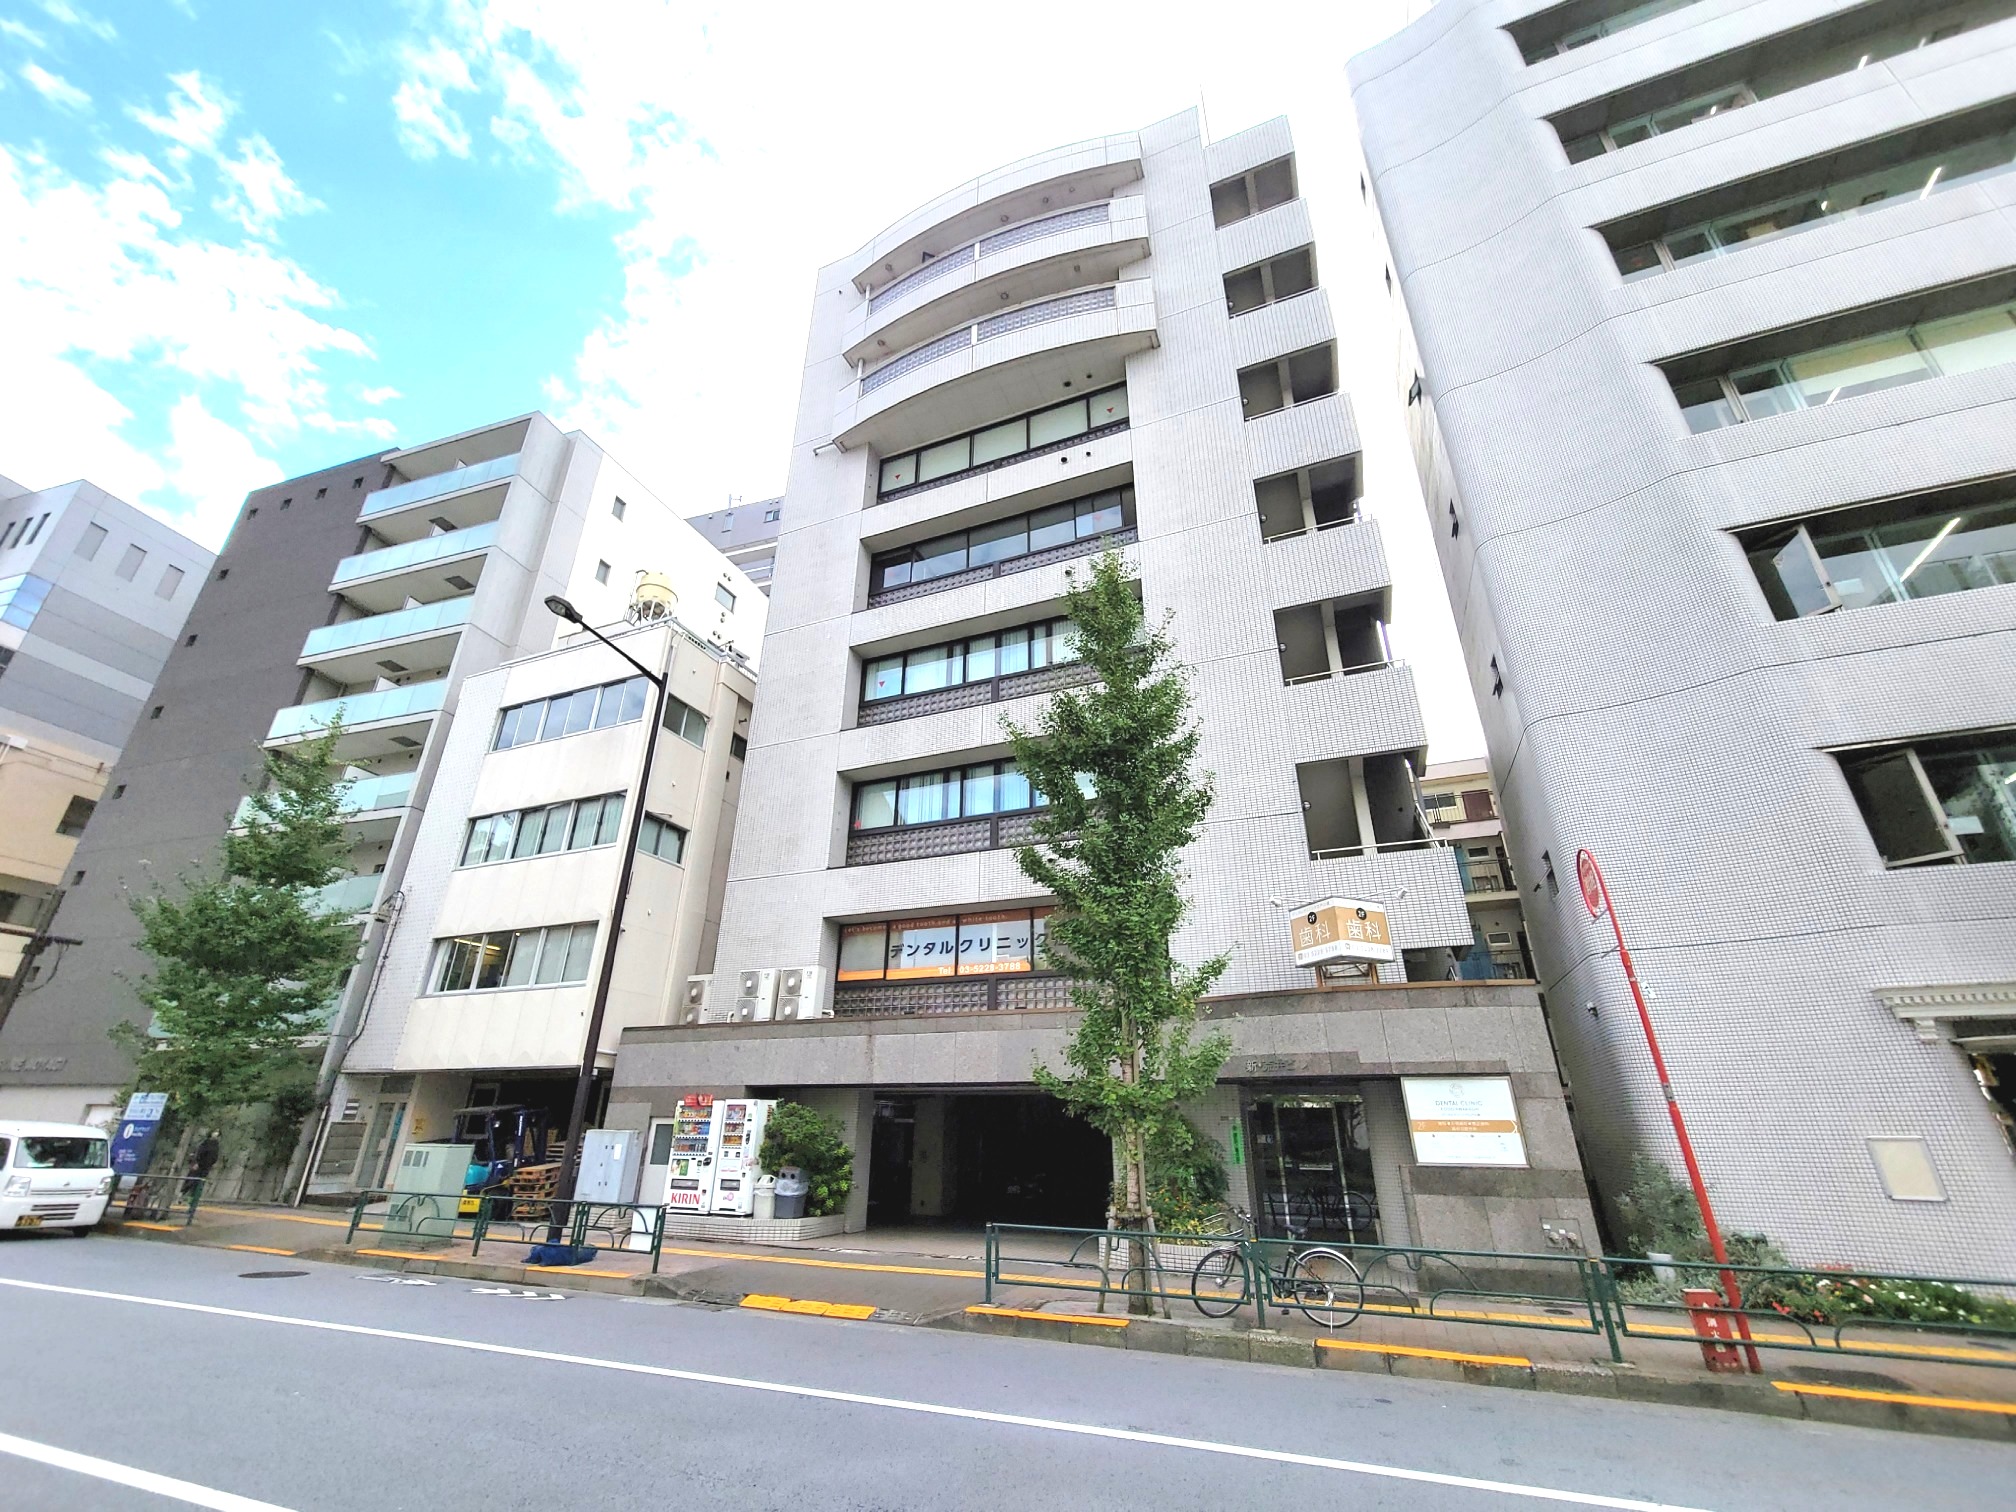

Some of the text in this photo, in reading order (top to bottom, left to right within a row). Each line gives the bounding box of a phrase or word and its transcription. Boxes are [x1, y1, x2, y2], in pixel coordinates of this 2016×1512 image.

[962, 915, 983, 924] white
[1299, 920, 1330, 947] 歯科
[1346, 918, 1381, 942] 歯科
[959, 961, 1021, 975] 03-5228-3788
[670, 1192, 701, 1205] KIRIN
